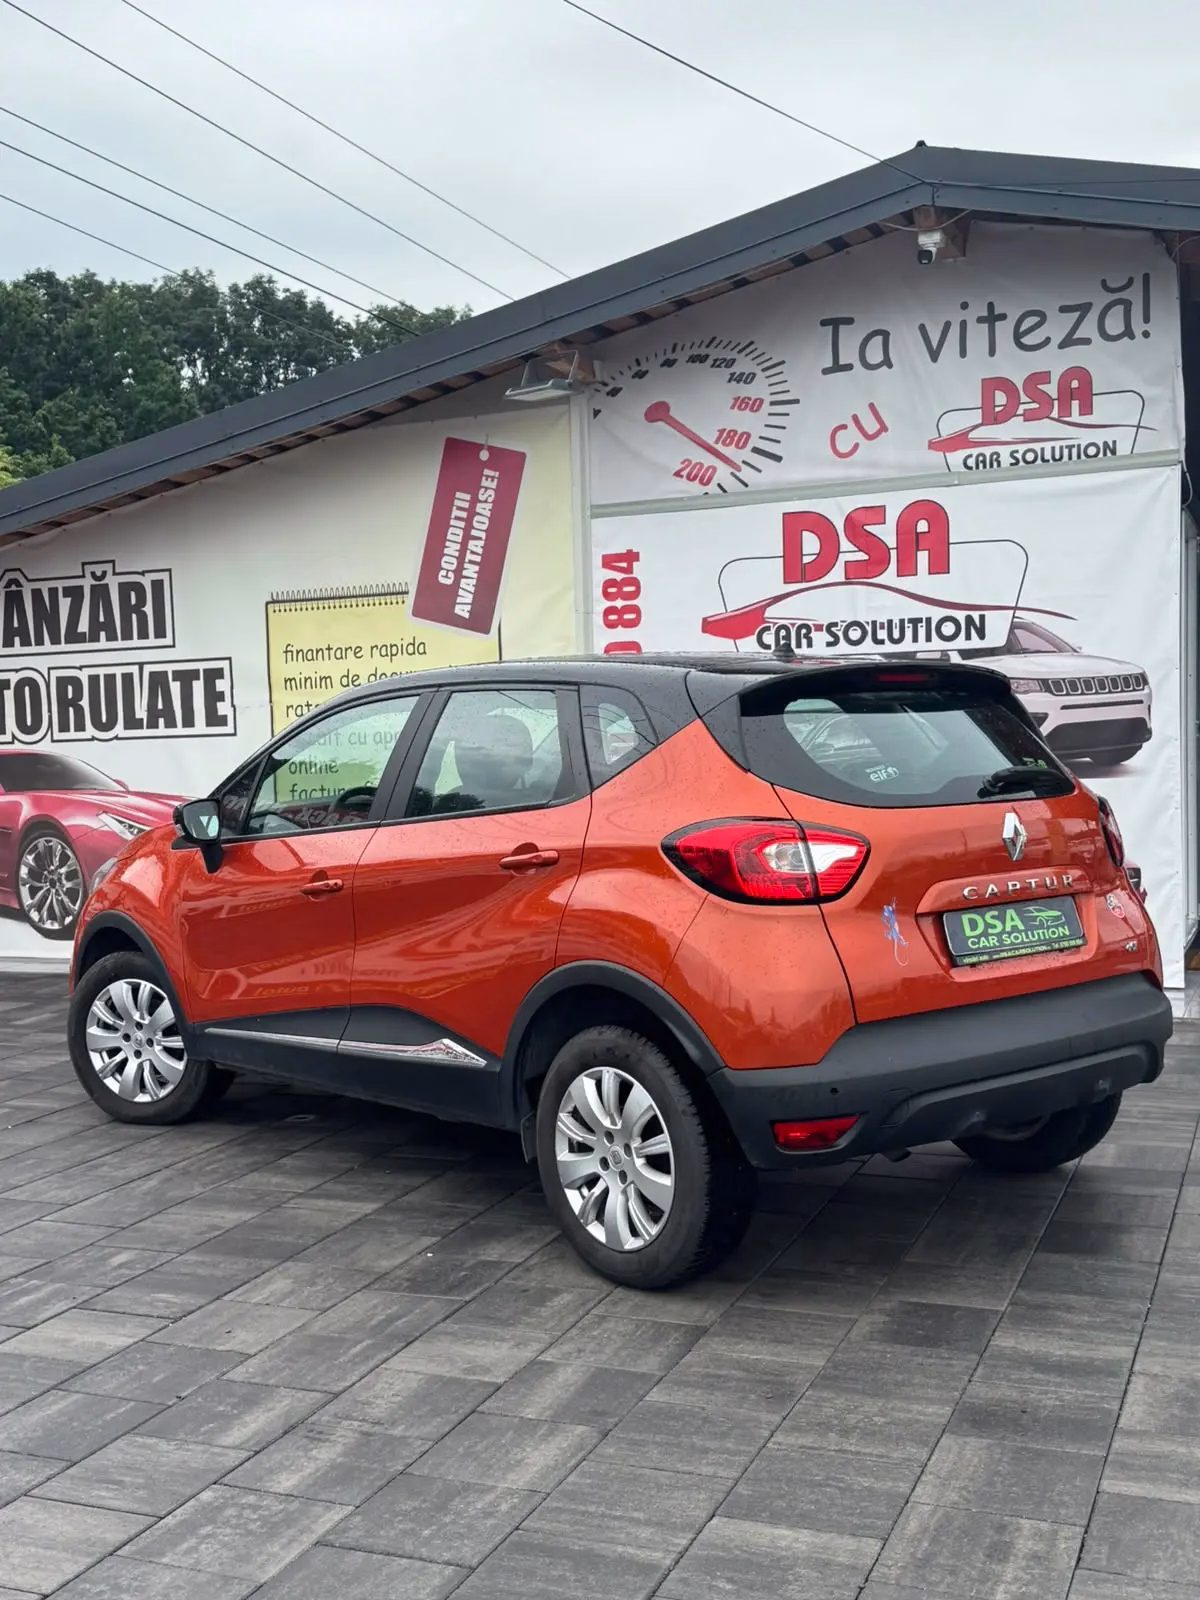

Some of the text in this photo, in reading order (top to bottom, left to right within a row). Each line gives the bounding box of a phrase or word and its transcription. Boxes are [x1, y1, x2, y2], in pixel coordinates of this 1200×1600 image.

[819, 272, 1151, 376] Ia viteză!
[710, 357, 737, 369] 120
[726, 372, 757, 385] 140
[729, 396, 765, 413] 160
[980, 365, 1094, 426] DSA
[713, 428, 752, 450] 180
[829, 402, 889, 459] cu
[962, 440, 1118, 471] CAR SOLUTION
[672, 458, 718, 486] 200
[437, 491, 472, 586] CONDITII
[454, 468, 500, 620] AVANTAJOASE!
[782, 499, 950, 585] DSA
[601, 549, 642, 630] 884
[756, 613, 987, 650] CAR SOLUTION
[283, 636, 428, 665] finantare rapida
[284, 671, 334, 691] minim
[339, 668, 362, 688] de
[55, 666, 229, 733] RULATE
[286, 700, 320, 718] rat
[961, 874, 1074, 900] CAPTUR
[961, 908, 1026, 937] DSA
[967, 936, 1000, 949] CAR
[1002, 925, 1070, 945] SOLUTION
